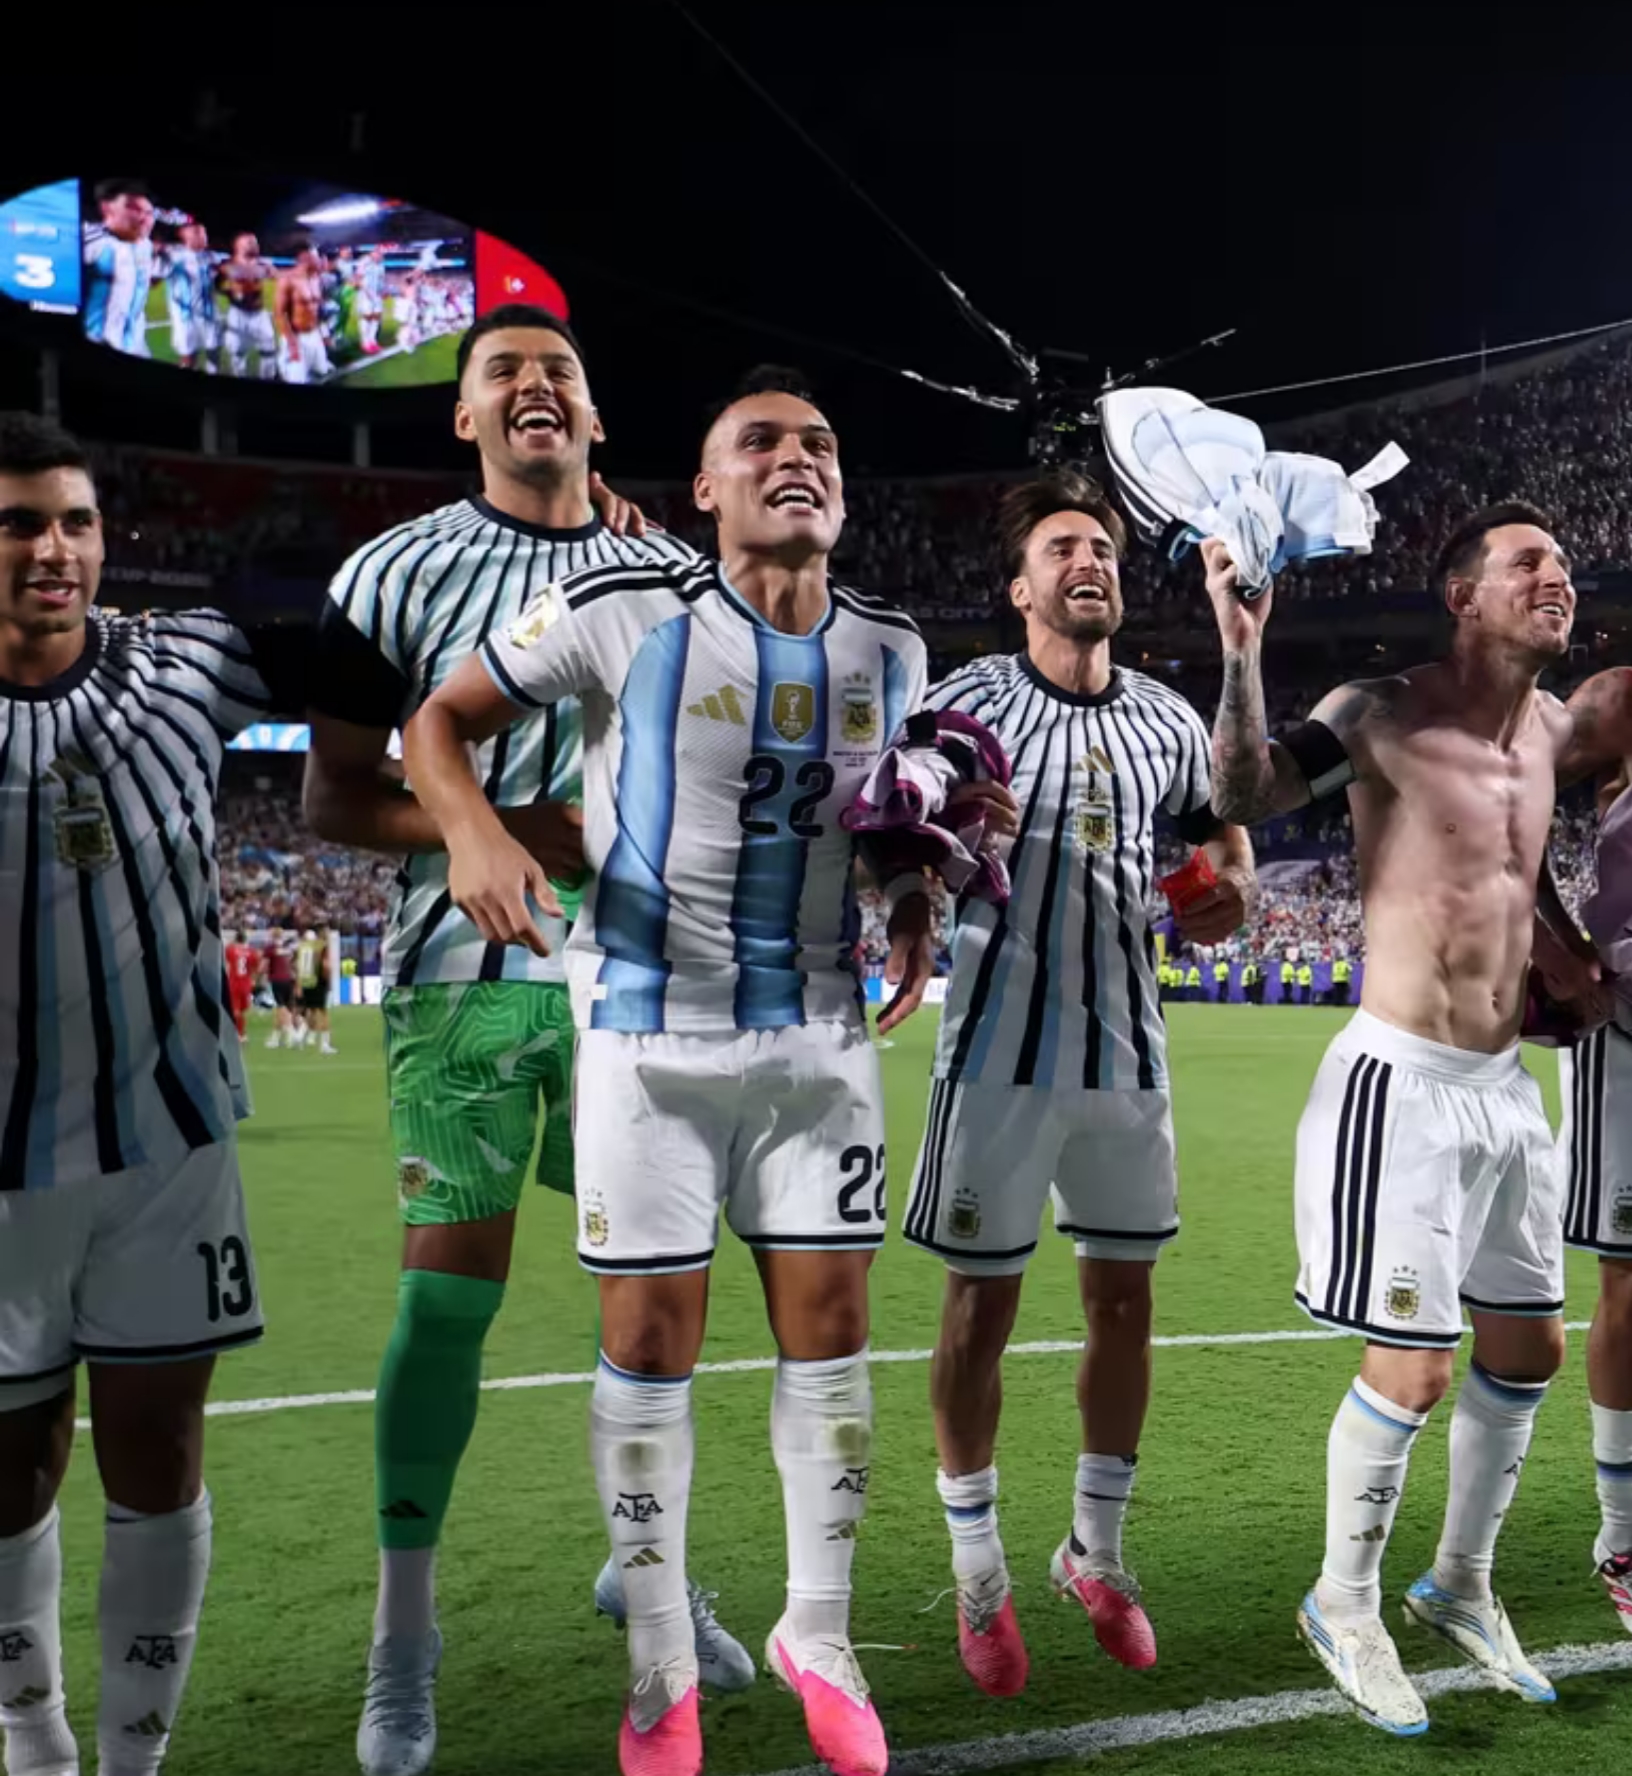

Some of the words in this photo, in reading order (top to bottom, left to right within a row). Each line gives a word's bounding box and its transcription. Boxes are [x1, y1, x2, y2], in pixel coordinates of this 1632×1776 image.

[16, 254, 55, 289] 3
[738, 755, 835, 838] 22
[197, 1234, 253, 1322] 13
[611, 1491, 664, 1523] AFA
[0, 1630, 34, 1662] FA
[125, 1634, 178, 1670] AFA
